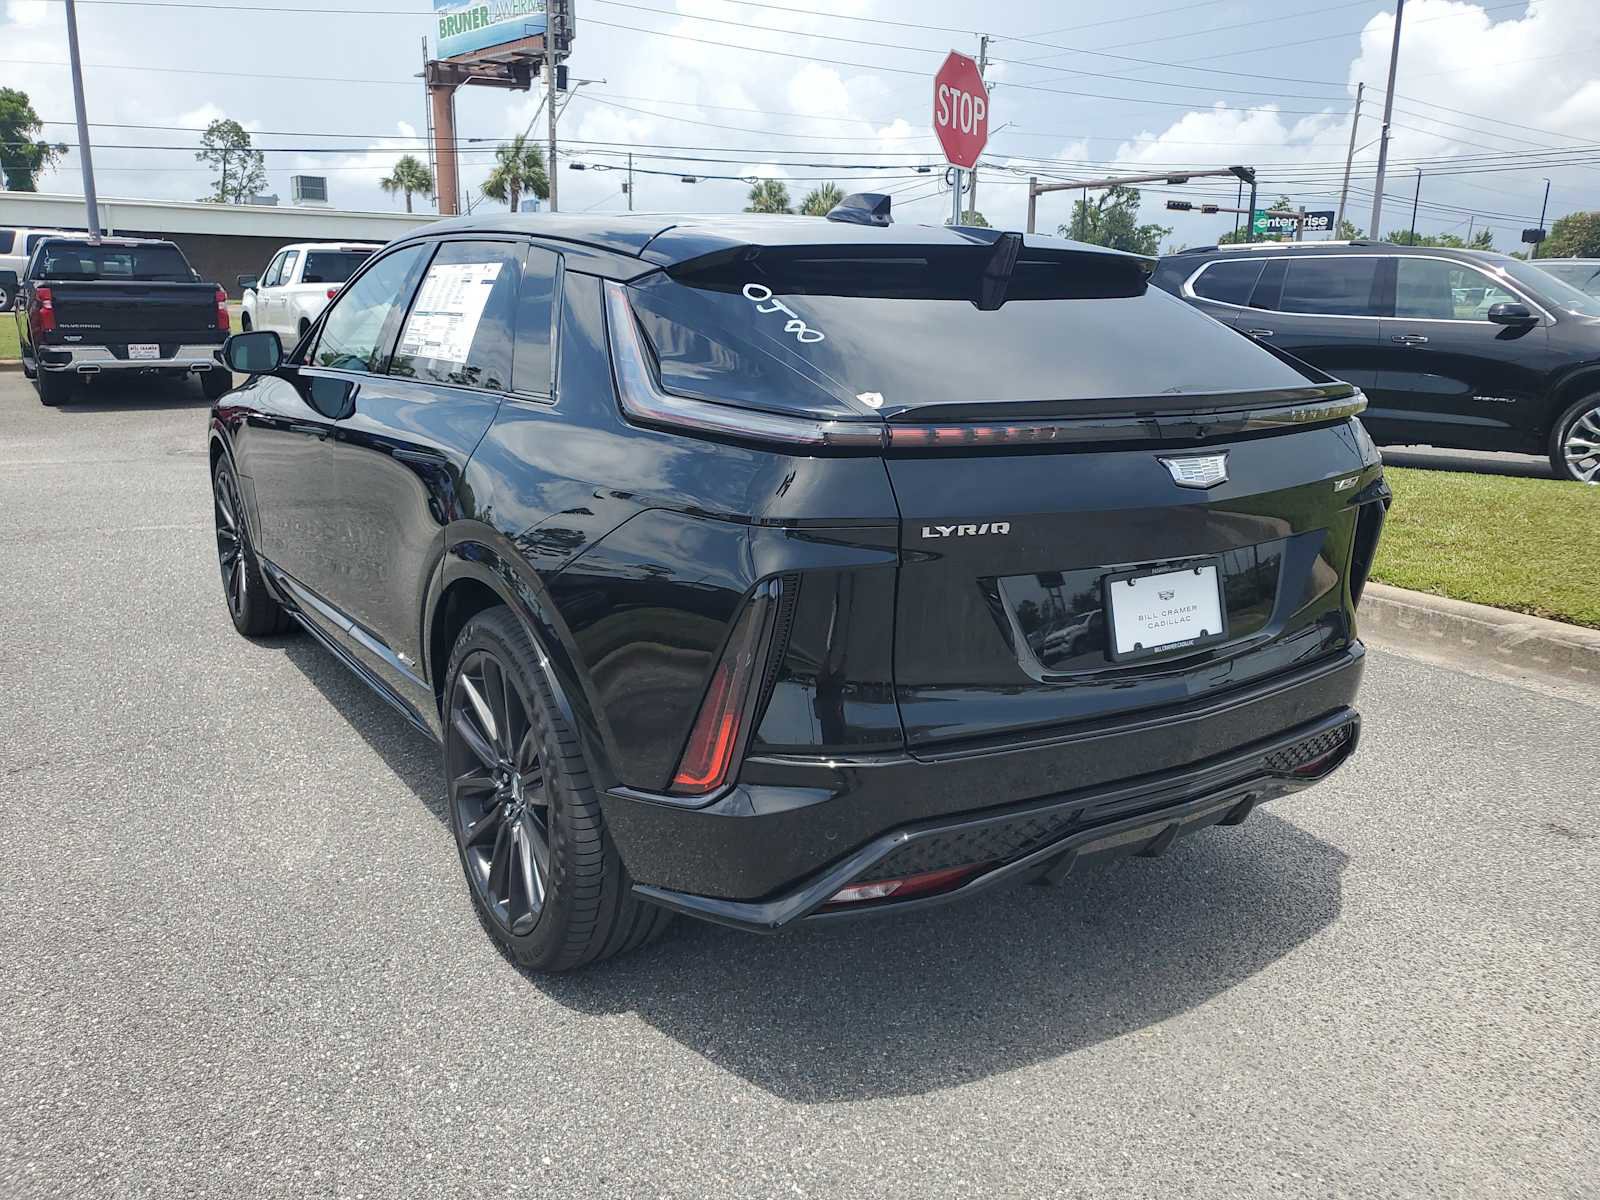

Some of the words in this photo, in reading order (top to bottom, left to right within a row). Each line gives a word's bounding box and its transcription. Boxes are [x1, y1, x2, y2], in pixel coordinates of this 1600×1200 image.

[439, 6, 489, 39] BRUNER
[937, 83, 986, 136] STOP
[1138, 611, 1158, 621] BILL
[1161, 604, 1198, 617] CRAMER
[1147, 615, 1191, 629] CADILLAC
